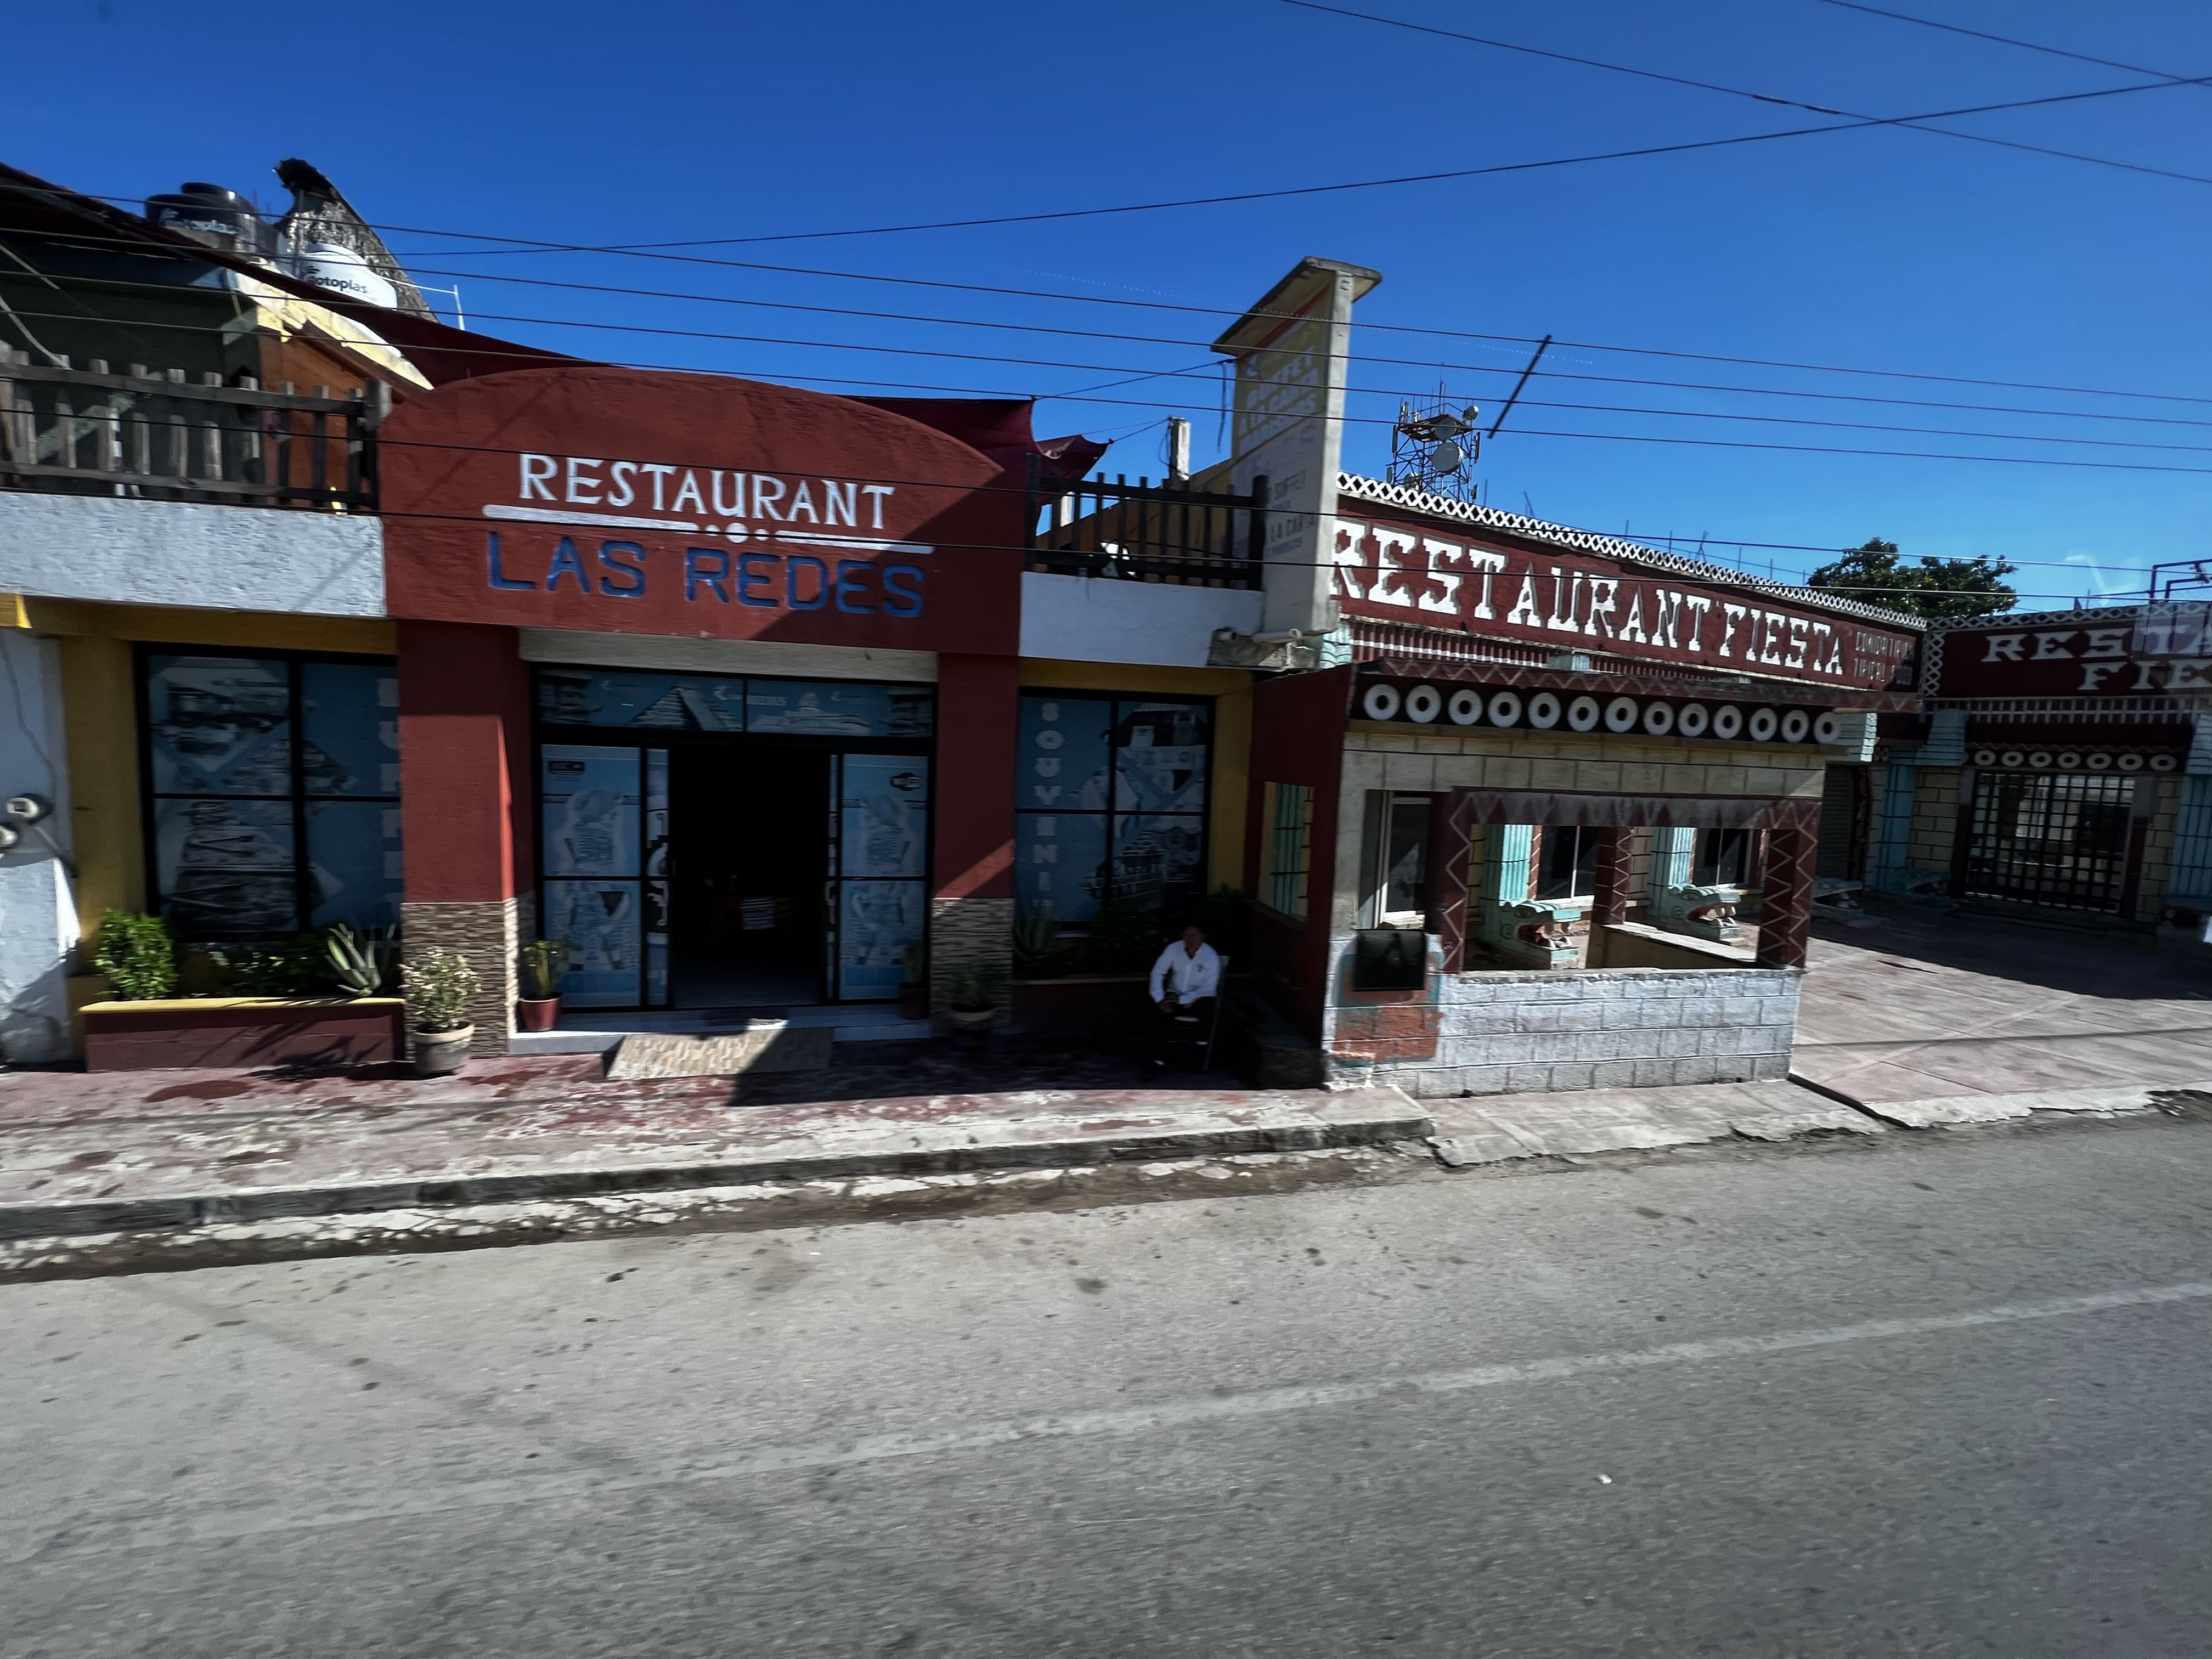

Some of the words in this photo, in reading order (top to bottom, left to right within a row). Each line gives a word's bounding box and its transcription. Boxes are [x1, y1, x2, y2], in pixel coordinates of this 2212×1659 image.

[518, 452, 895, 530] RESTAURANT
[487, 531, 647, 599] LAS
[684, 547, 925, 618] REDES
[1328, 517, 1712, 652] RESTAURANT
[1718, 602, 1844, 676] FIESTA
